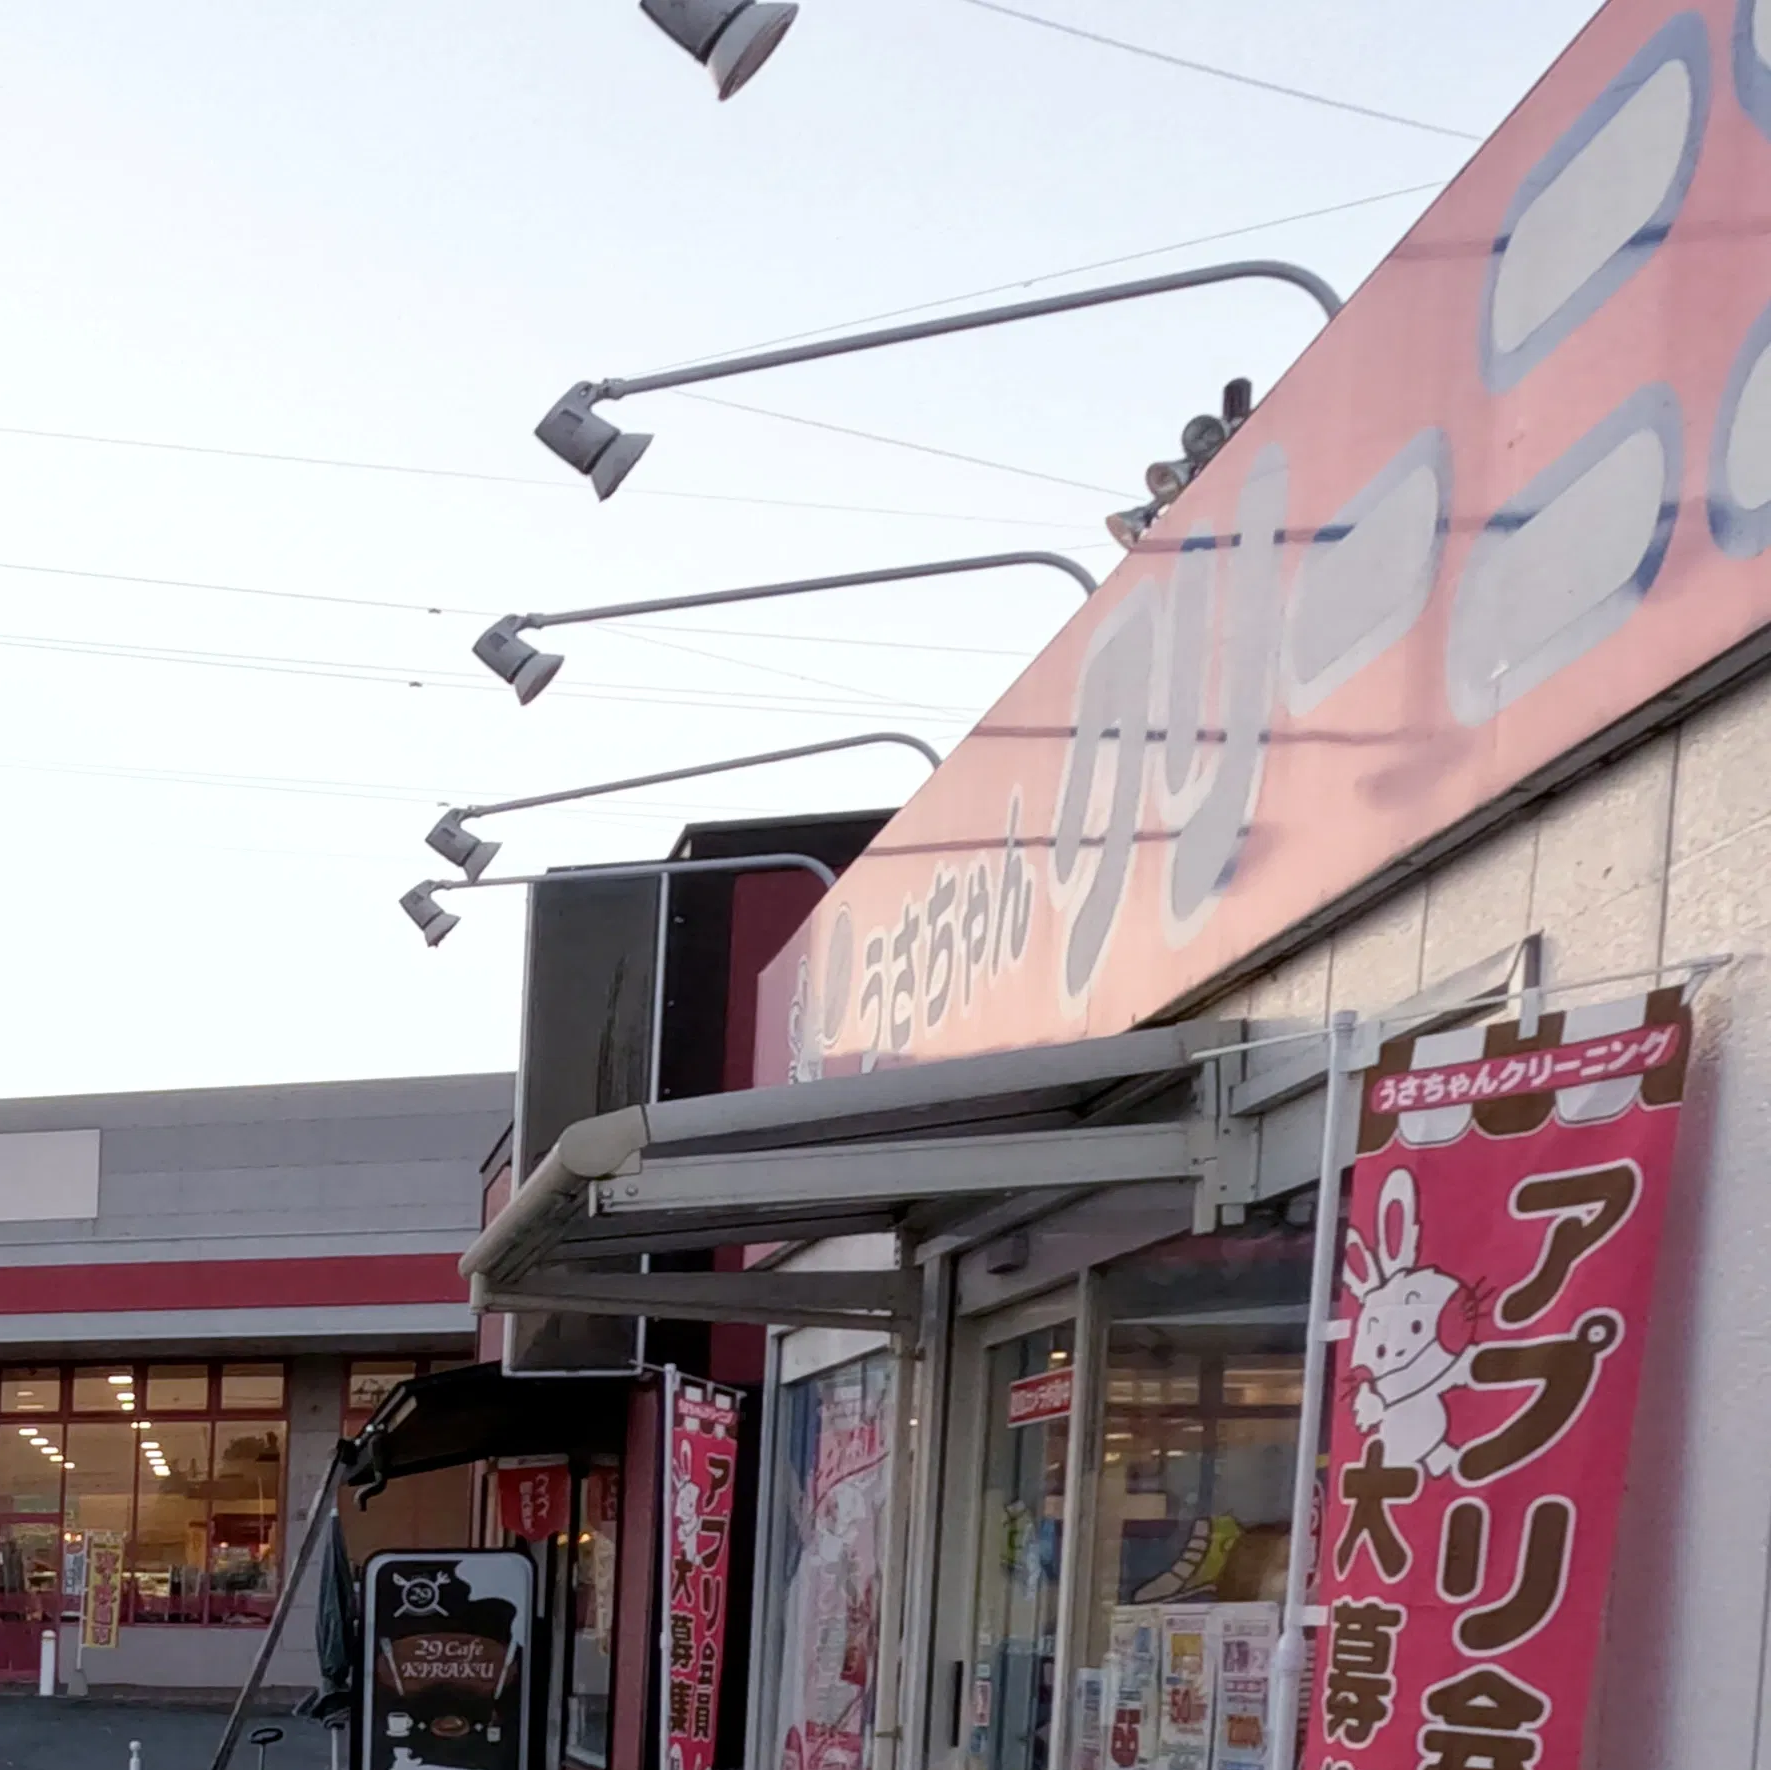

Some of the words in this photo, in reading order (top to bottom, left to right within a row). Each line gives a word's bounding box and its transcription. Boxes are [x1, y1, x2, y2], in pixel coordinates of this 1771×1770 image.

[859, 784, 1036, 1074] うさちゃん
[1050, 0, 1771, 1017] クリーニ
[1377, 1026, 1675, 1111] うさちゃんクリーニング
[401, 1661, 496, 1680] KIRAKU
[414, 1639, 442, 1660] 29
[445, 1638, 485, 1662] Cafe
